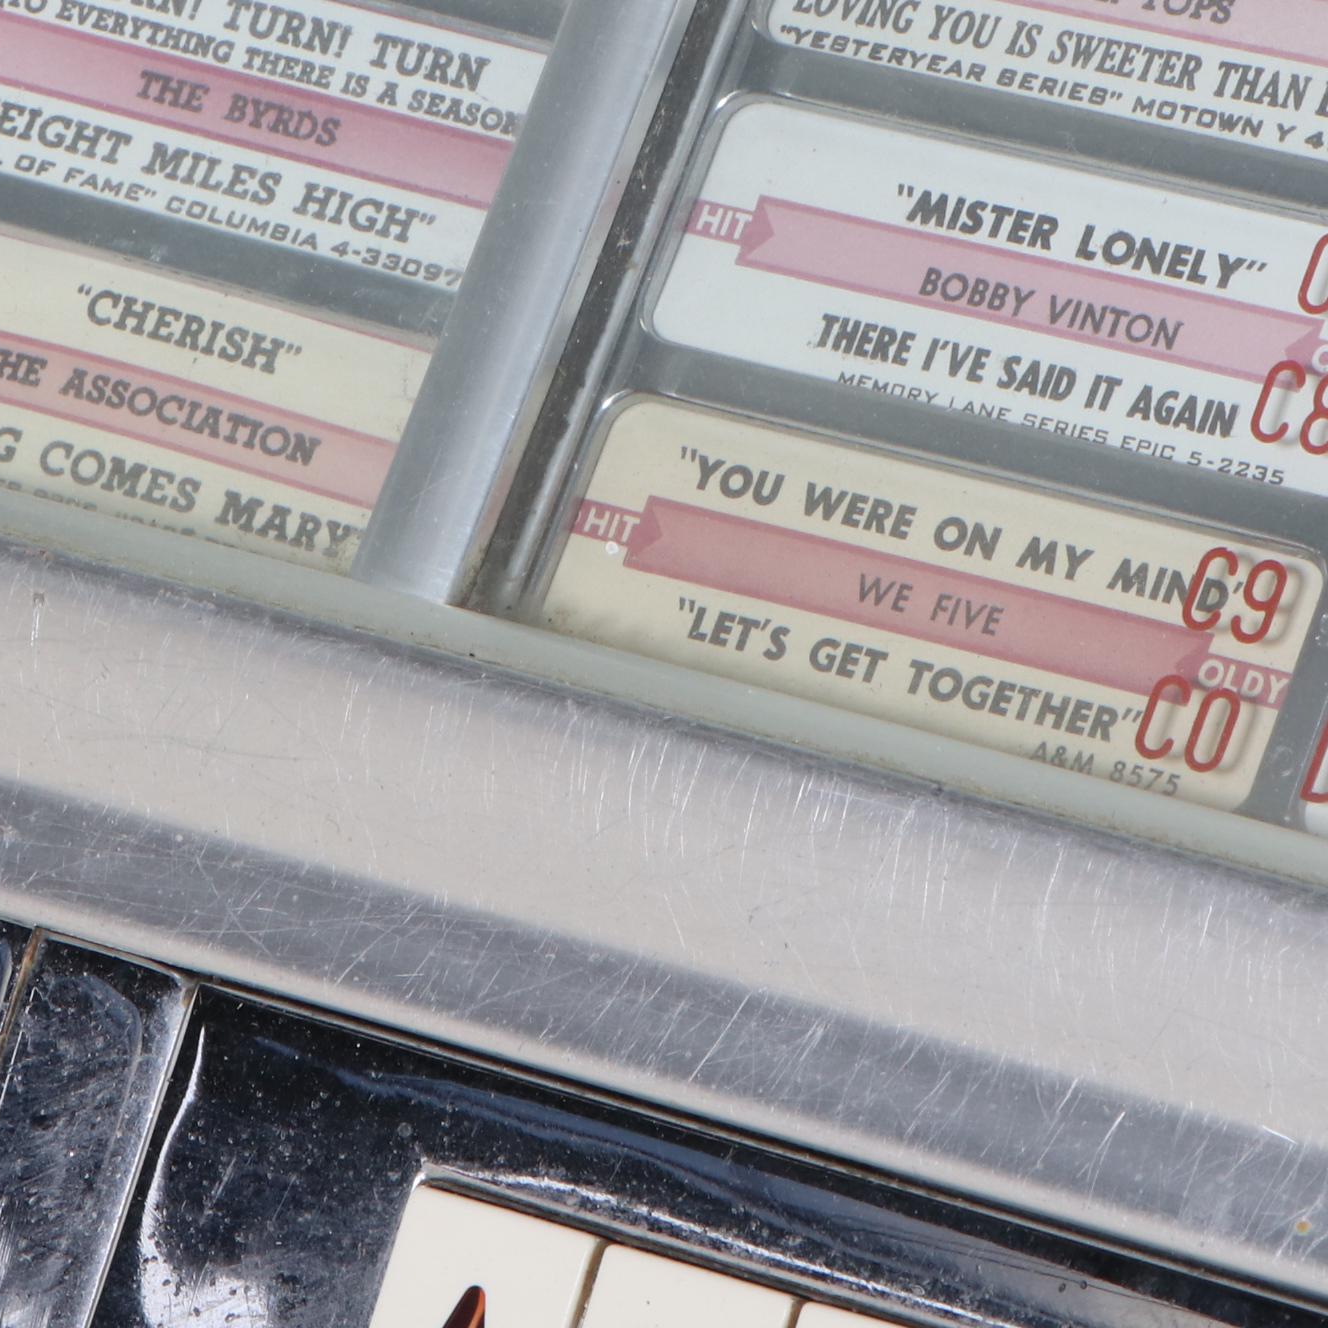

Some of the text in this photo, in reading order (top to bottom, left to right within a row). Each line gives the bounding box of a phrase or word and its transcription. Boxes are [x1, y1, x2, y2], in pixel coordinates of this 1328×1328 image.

[369, 32, 491, 91] TURN
[137, 69, 341, 146] THE BYRDS
[1132, 96, 1263, 138] MOTOWN
[1276, 123, 1296, 142] Y
[140, 142, 282, 205] MILES
[292, 182, 435, 243] HIGH"
[898, 184, 1267, 289] "MISTER LONELY"
[77, 284, 302, 374] "CHERISH"
[918, 267, 1184, 350] BOBBY VINTON
[59, 367, 321, 466] ASSOCIATION
[816, 313, 1239, 438] THERE I'VE SAID IT AGAIN
[859, 573, 1004, 636] WE FIVE
[679, 597, 1143, 742] "LET'S GET TOGETHER"
[1028, 741, 1184, 800] A&M 8575
